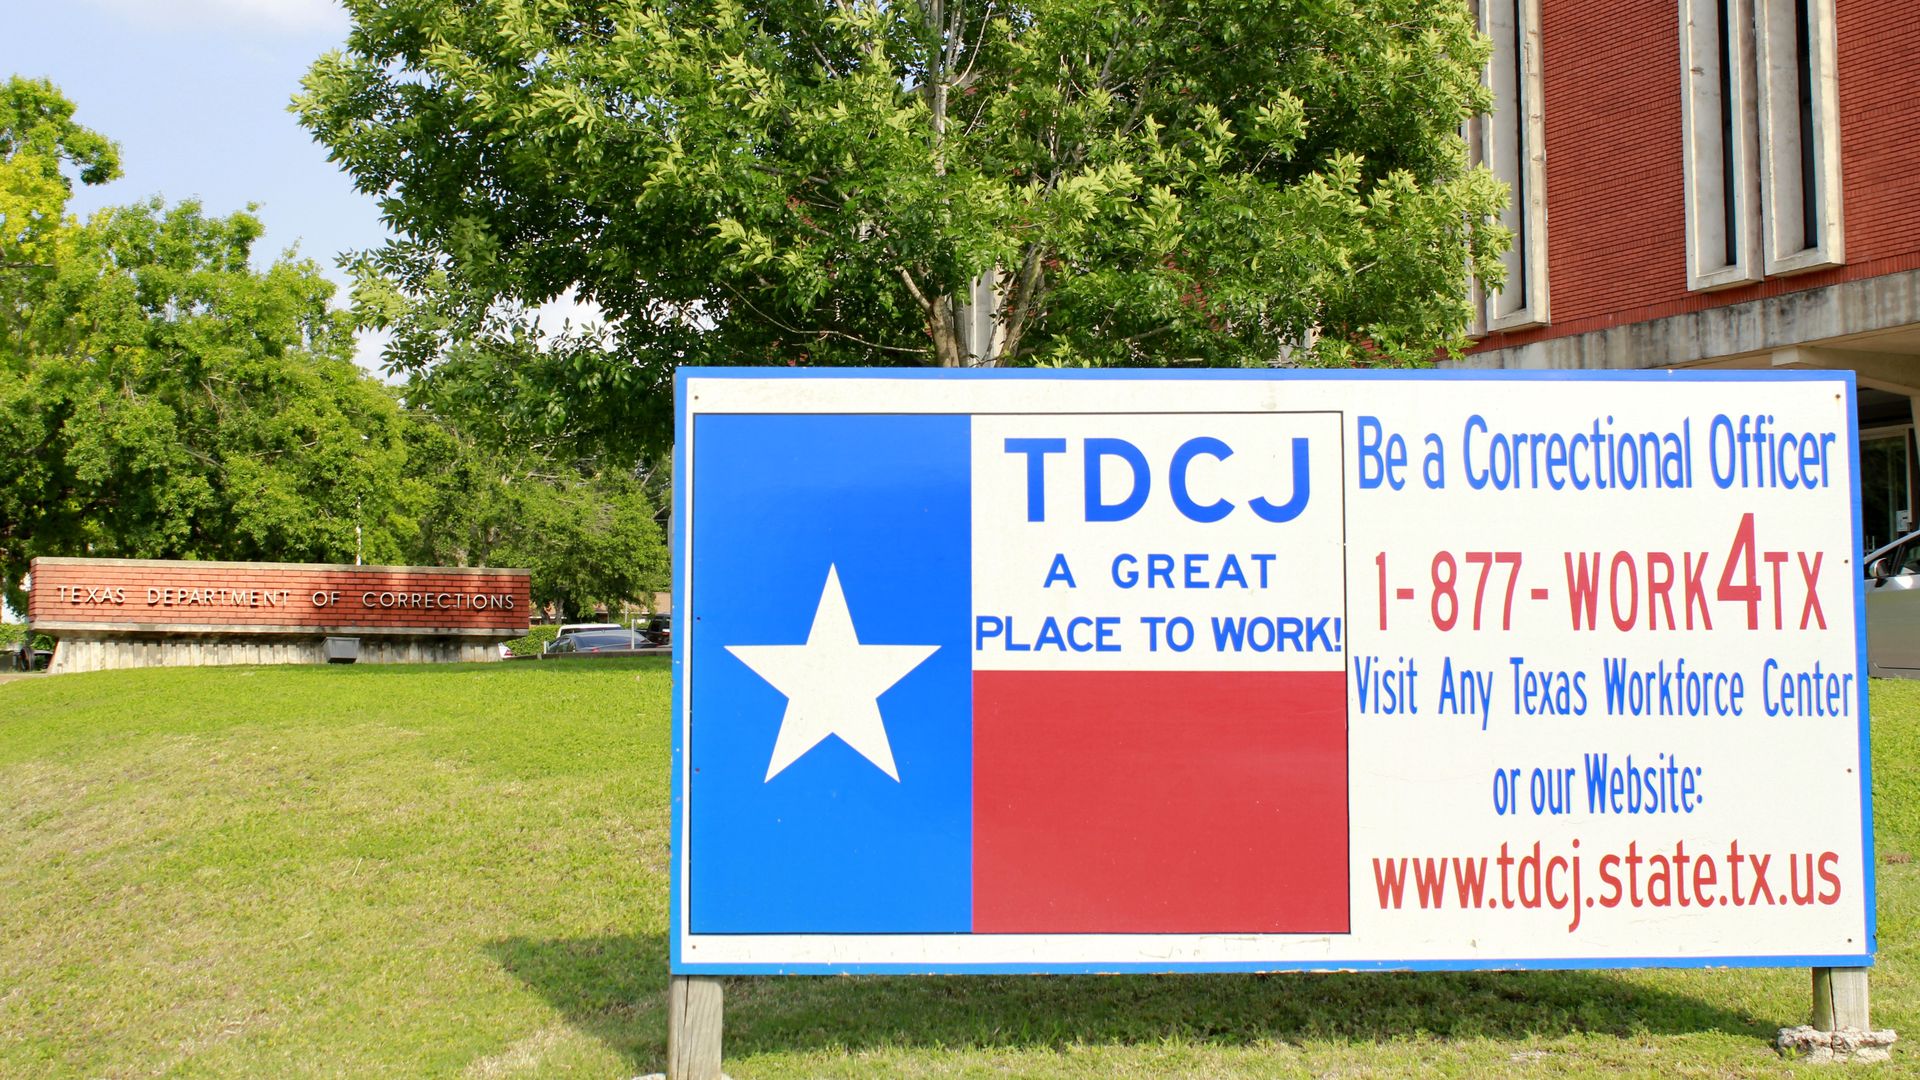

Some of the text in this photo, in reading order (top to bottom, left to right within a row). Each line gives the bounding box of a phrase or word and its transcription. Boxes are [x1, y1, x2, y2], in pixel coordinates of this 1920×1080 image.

[1004, 436, 1310, 523] TDCJ
[1357, 413, 1836, 491] Be a Correctional Officer
[57, 585, 515, 611] TEXAS DEPARTMENT OF CORRECTIONS
[1043, 553, 1277, 589] A GREAT
[1375, 512, 1828, 632] 1-877-WORK4TX
[976, 615, 1342, 652] PLACE TO WORK!
[1354, 655, 1853, 730] Visit Any Texas Workforce Center
[1492, 753, 1703, 815] or our Website:
[1372, 838, 1842, 933] www.tdcj.state.tx.us
